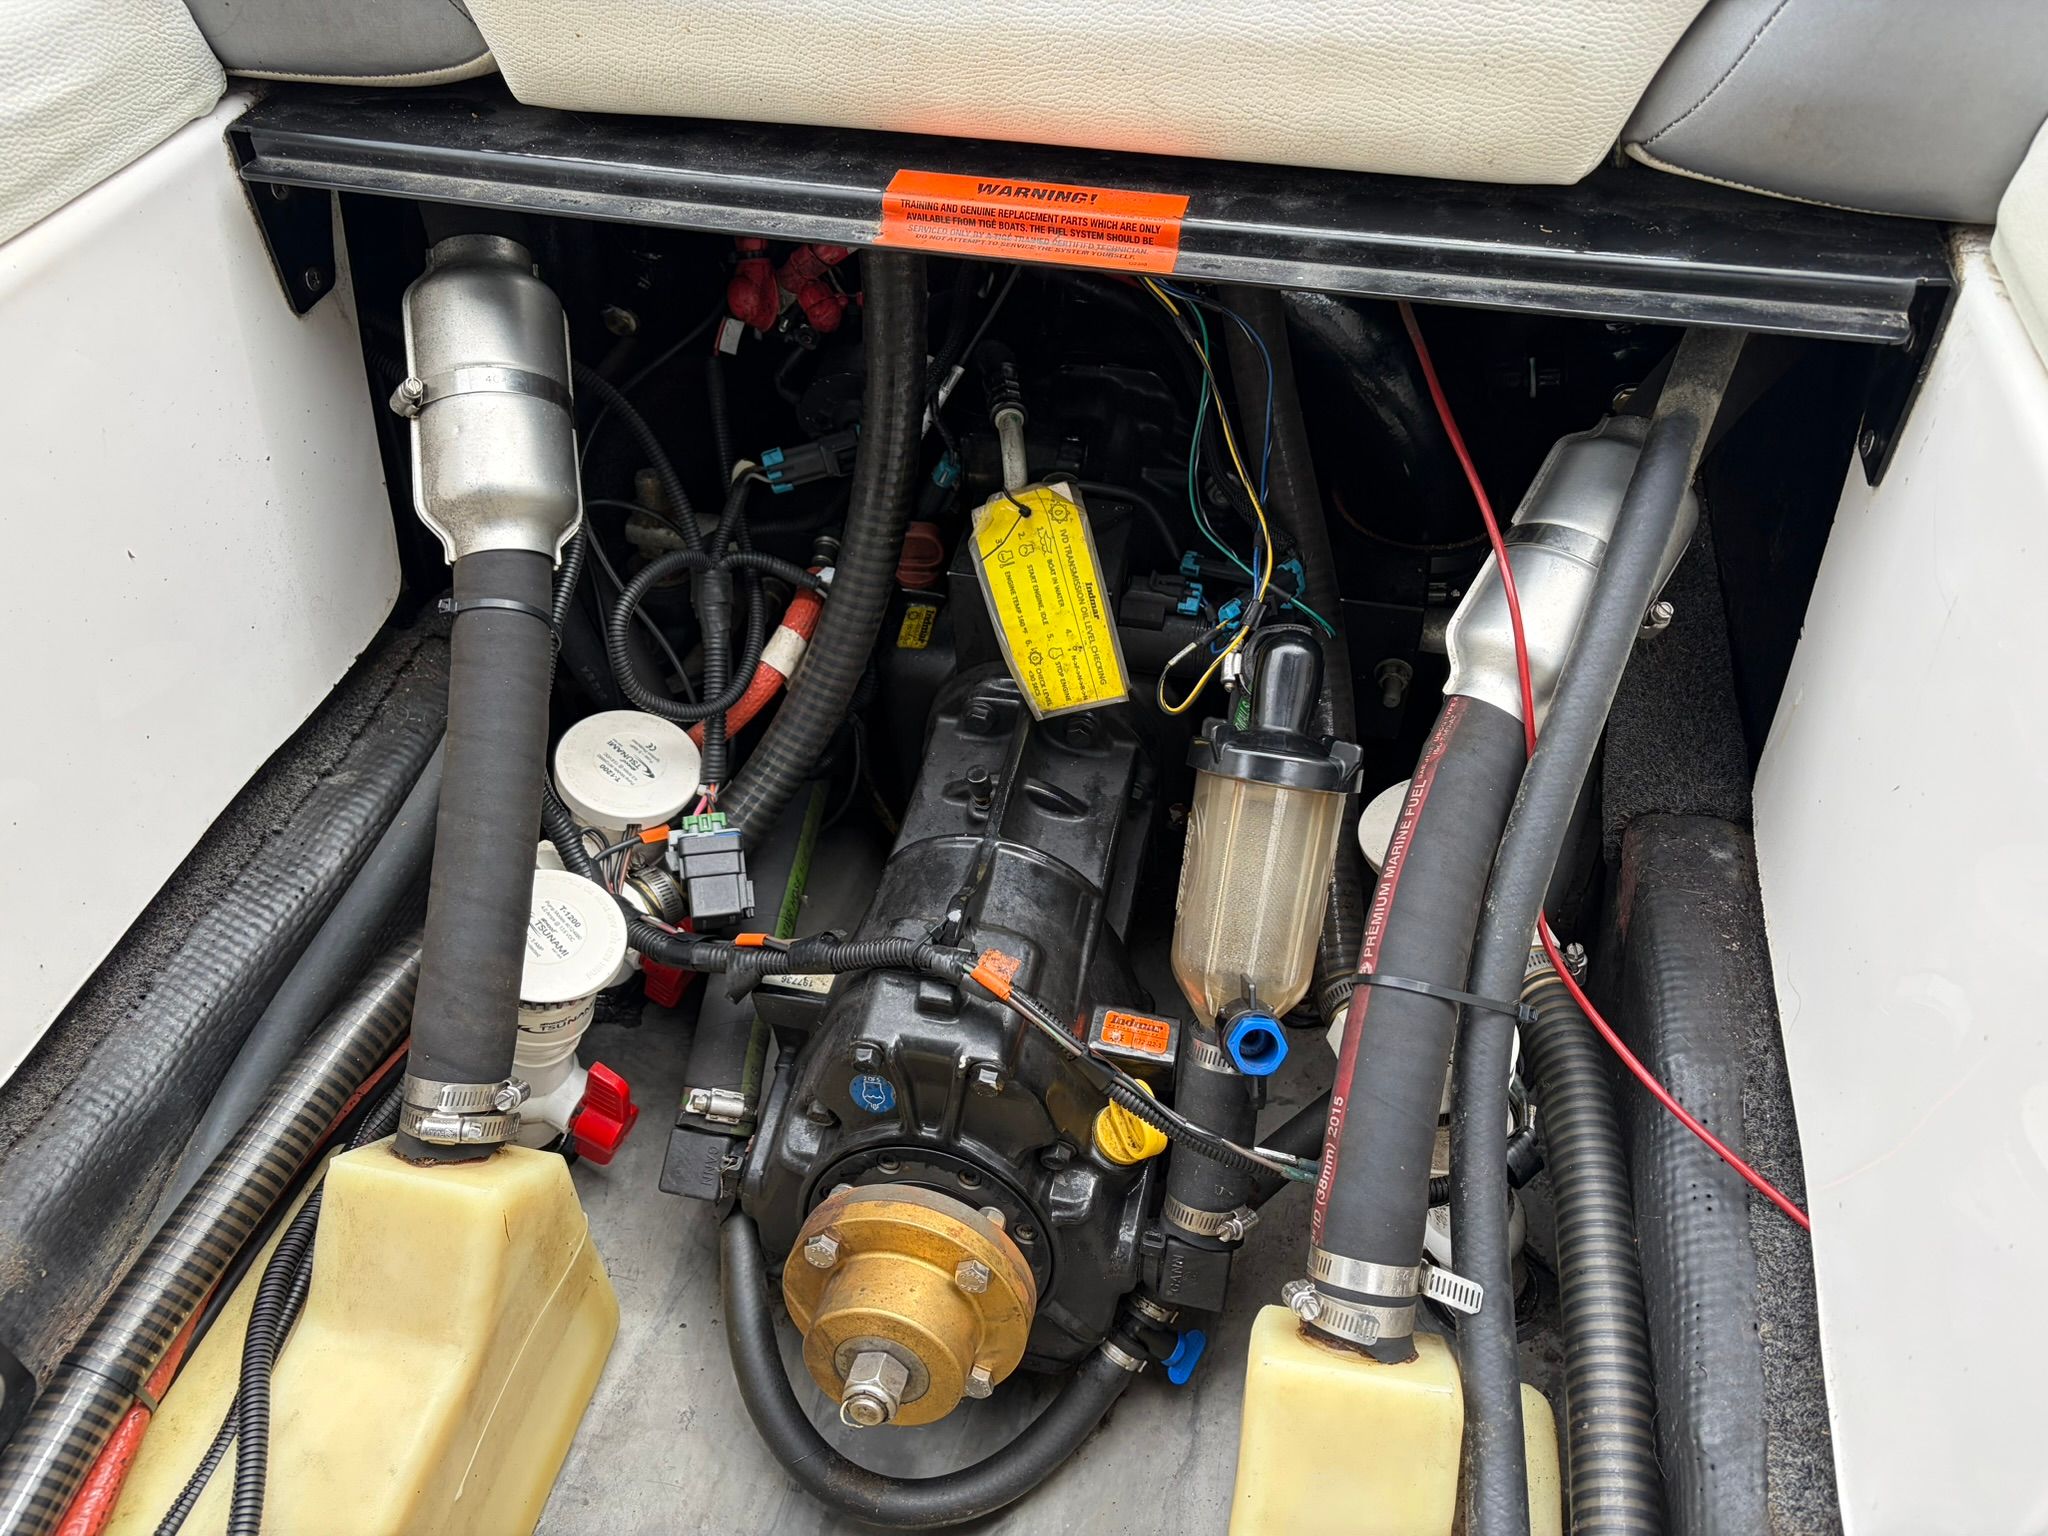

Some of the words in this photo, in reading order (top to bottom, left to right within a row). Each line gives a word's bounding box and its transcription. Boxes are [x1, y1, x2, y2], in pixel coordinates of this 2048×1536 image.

[978, 184, 1096, 204] WARNING!
[901, 199, 938, 211] TRAINING
[940, 204, 957, 213] AND
[961, 205, 995, 217] GENUINE
[998, 209, 1058, 223] REPLACEMENT
[1061, 215, 1088, 226] PARTS
[1091, 219, 1117, 230] WHICH
[1120, 222, 1137, 231] ARE
[1139, 224, 1160, 234] ONLY
[906, 212, 950, 223] AVAILABLE
[952, 217, 976, 226] FROM
[978, 219, 996, 229] TIGÉ
[999, 221, 1028, 232] BOATS.
[1030, 224, 1045, 233] THE
[1047, 226, 1068, 236] FUEL
[1070, 229, 1104, 239] SYSTEM
[1106, 233, 1140, 244] SHOULD
[1143, 237, 1154, 245] BE
[908, 224, 948, 234] SERVICED
[950, 229, 970, 237] ONLY
[1054, 239, 1095, 250] CERTIFIED
[948, 237, 984, 245] ATTEMPT
[1000, 242, 1035, 250] SERVICE
[1060, 529, 1069, 543] IVD
[1005, 571, 1016, 595] ENGINE
[1013, 596, 1022, 614] TEMP
[1047, 559, 1056, 575] BOAT
[1055, 585, 1064, 607] WATER
[1065, 546, 1084, 604] TRANSMISSION
[1027, 564, 1037, 583] START
[1033, 585, 1044, 611] ENGINE,
[1040, 611, 1049, 625] IDLE
[1085, 582, 1099, 619] Indmar
[1080, 606, 1089, 620] OIL
[1084, 621, 1095, 644] LEVEL
[1025, 639, 1032, 647] 6.
[1036, 667, 1046, 688] CHECK
[1042, 689, 1052, 706] LEVEL
[1046, 633, 1054, 641] 5.
[1055, 661, 1064, 677] STOP
[1060, 678, 1072, 702] ENGINE
[1091, 645, 1107, 685] CHECKING
[1032, 682, 1040, 697] SECS
[607, 741, 640, 768] TSUNAMI
[599, 764, 620, 782] T-1200
[1364, 882, 1391, 958] PREMIUM
[1384, 819, 1412, 878] MARINE
[1405, 779, 1427, 816] FUEL
[560, 905, 581, 927] T-1200
[535, 920, 568, 956] TSUNAMI
[1328, 1095, 1344, 1137] 2015
[1316, 1143, 1337, 1205] (38mm)
[1313, 1210, 1322, 1230] ID
